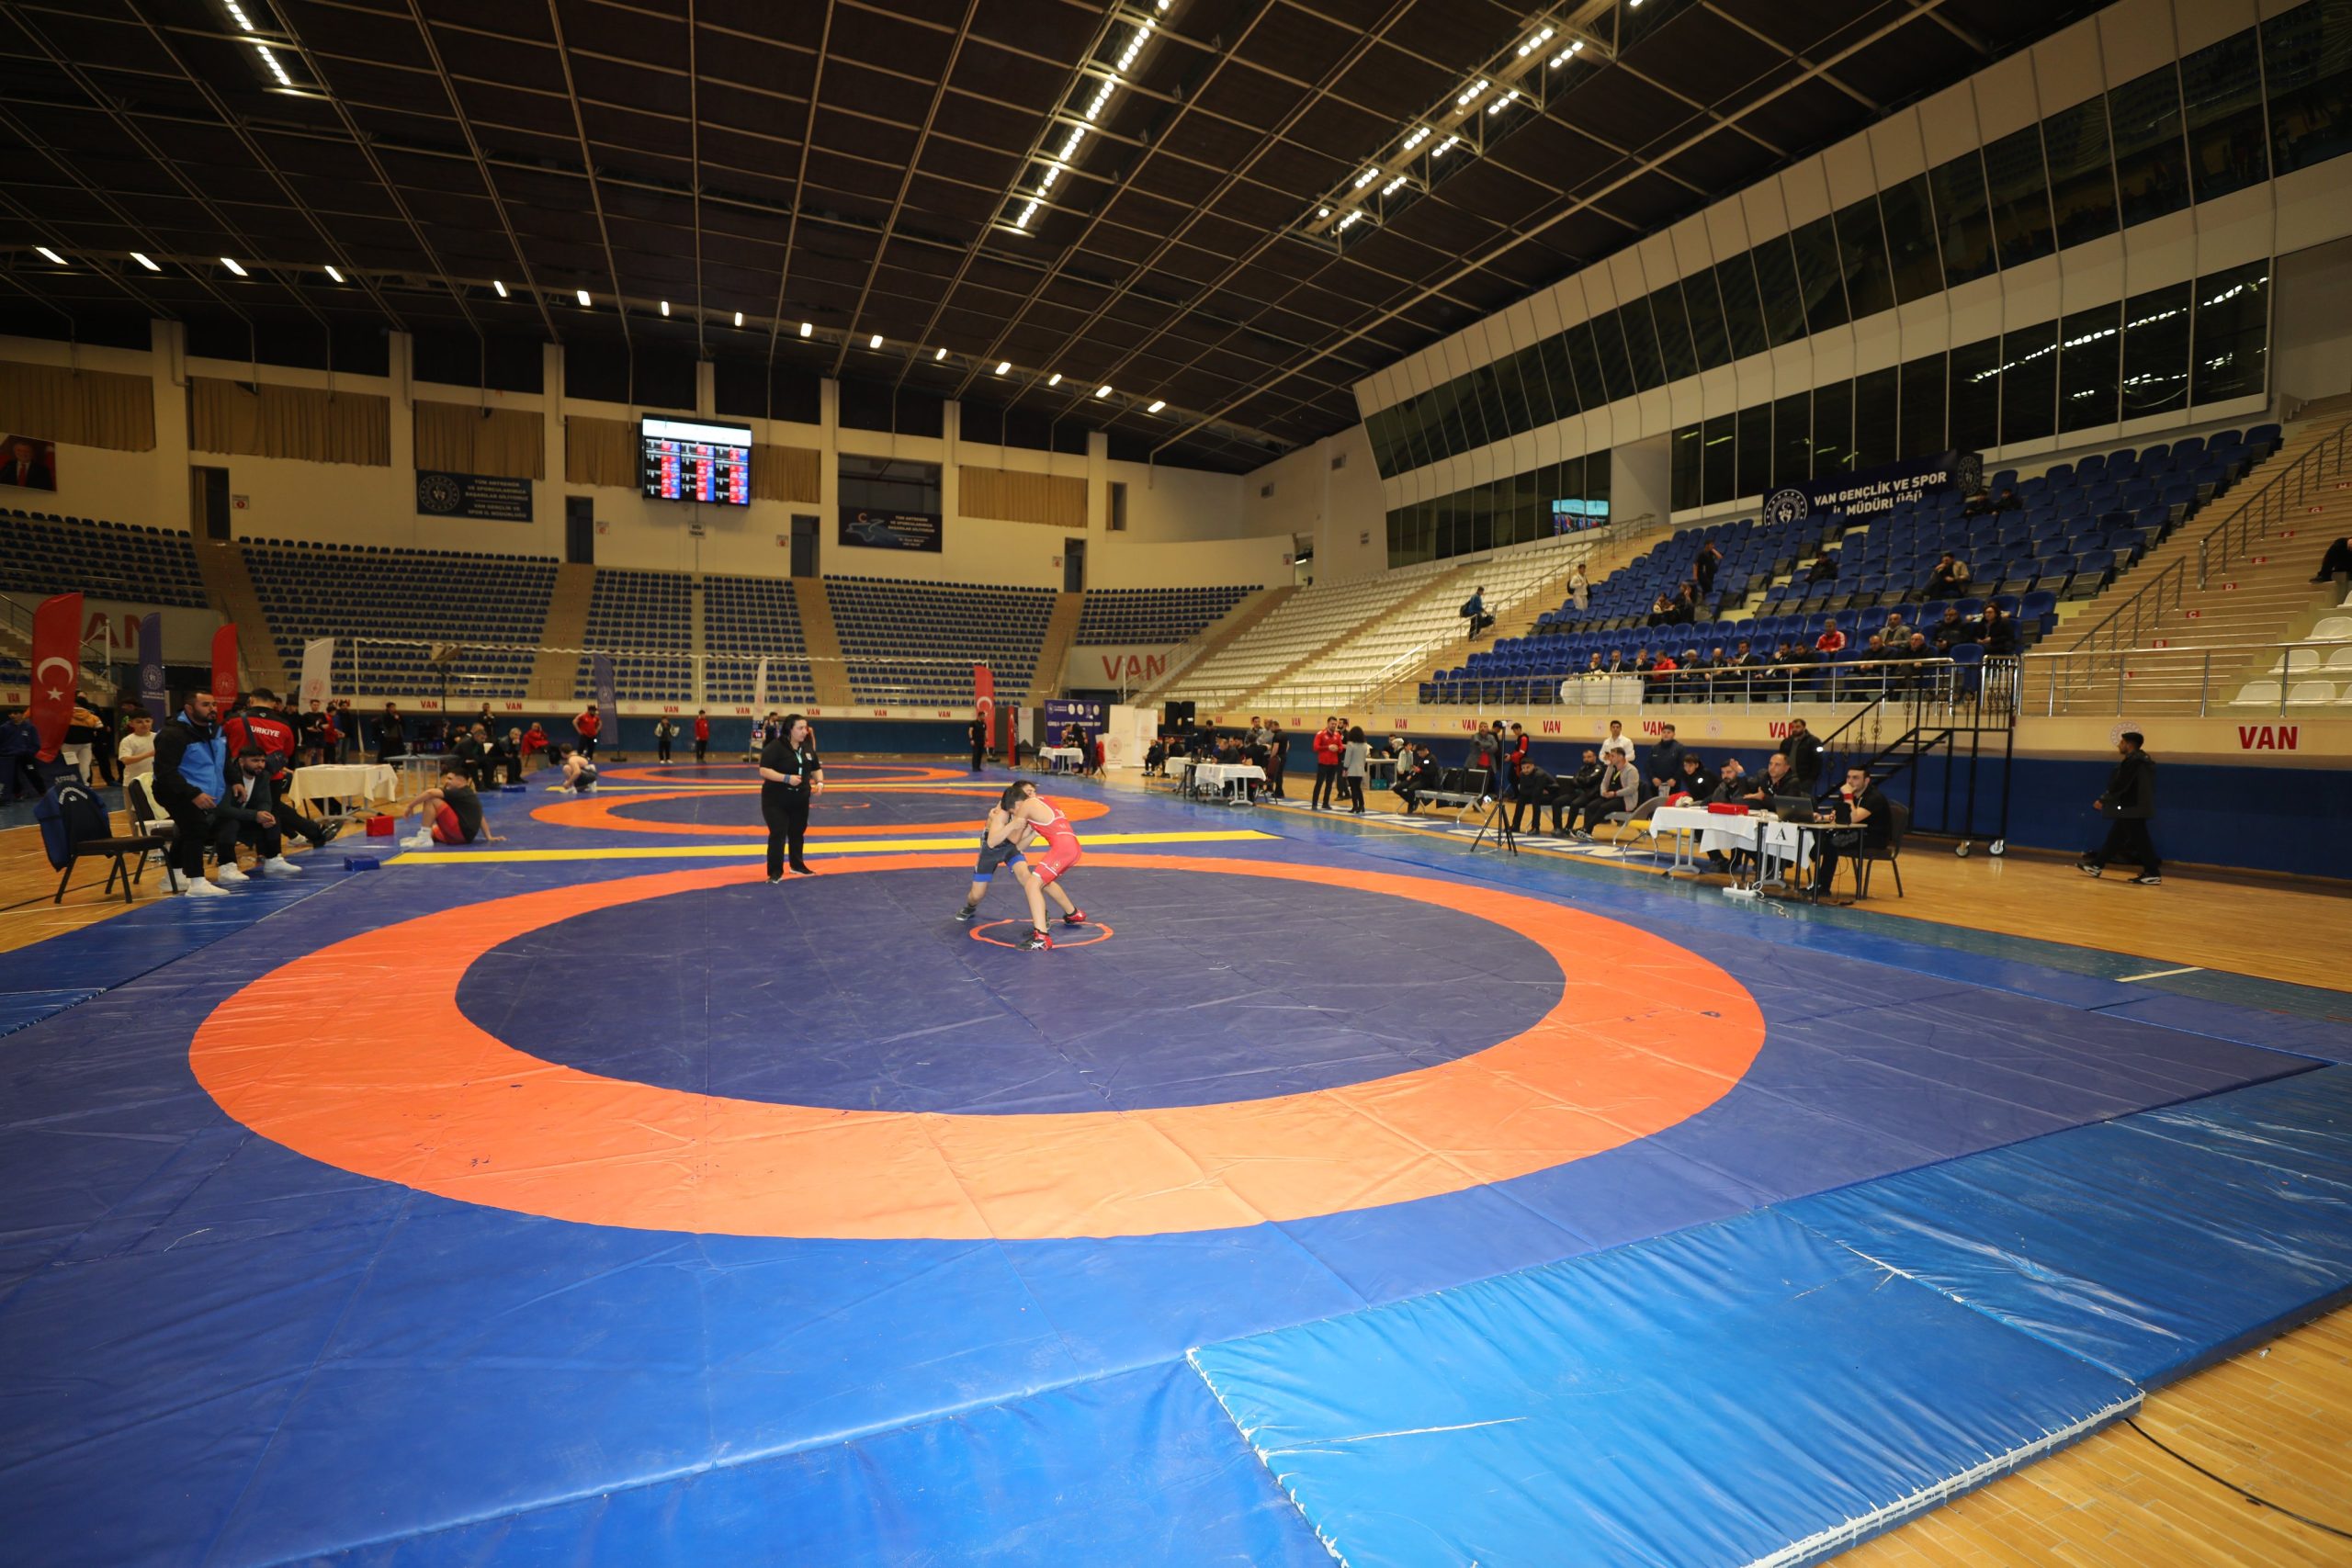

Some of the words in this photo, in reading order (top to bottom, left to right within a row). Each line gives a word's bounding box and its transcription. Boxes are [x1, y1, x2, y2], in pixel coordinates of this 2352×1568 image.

[1814, 492, 1837, 507] VAN
[1839, 480, 1891, 502] GENÇLİK
[1893, 478, 1911, 491] VE
[1912, 471, 1947, 489] SPOR
[1102, 654, 1166, 682] VAN
[6, 693, 20, 704] VAN
[420, 700, 438, 709] VAN
[505, 702, 523, 710] VAN
[663, 705, 679, 714] VAN
[736, 706, 751, 715] VAN
[806, 708, 820, 716] VAN
[874, 709, 888, 717] VAN
[938, 710, 951, 718] VAN
[1291, 717, 1302, 727] VAN
[1395, 718, 1408, 730] VAN
[1462, 719, 1478, 732] VAN
[1543, 720, 1562, 734] VAN
[2238, 726, 2299, 750] VAN
[1775, 828, 1787, 840] A
